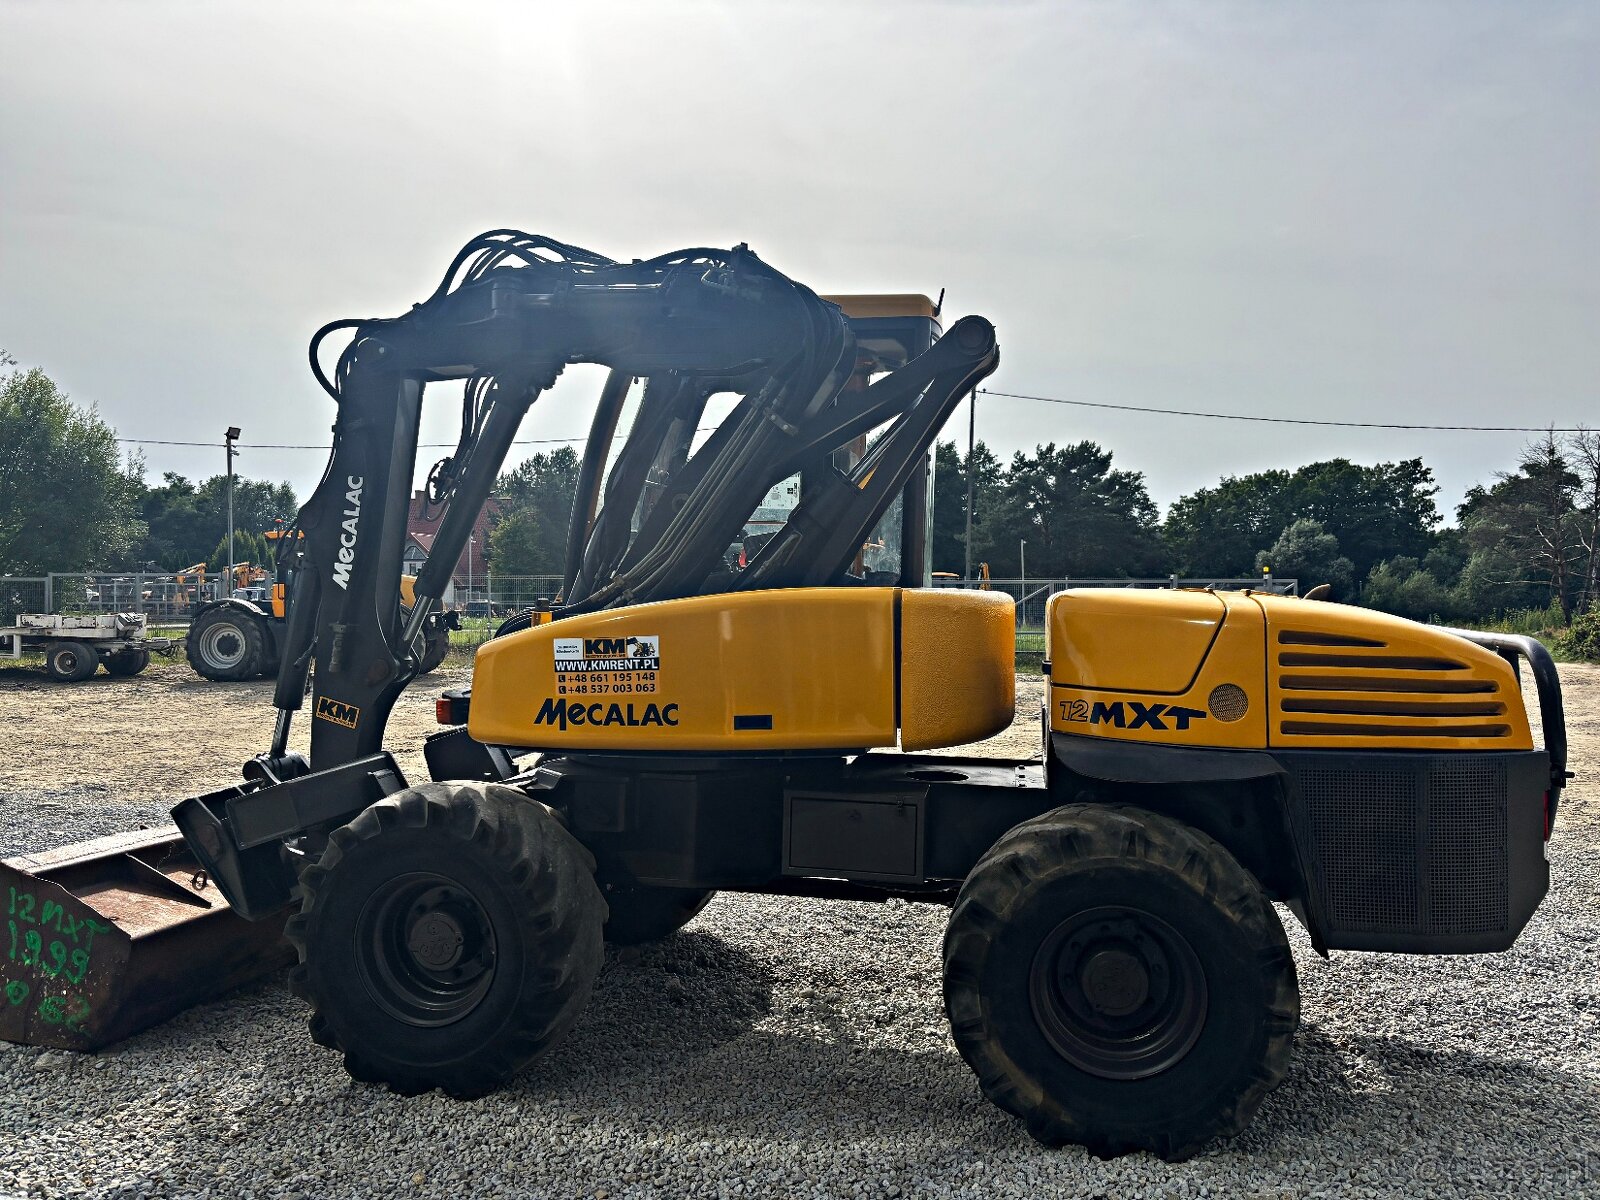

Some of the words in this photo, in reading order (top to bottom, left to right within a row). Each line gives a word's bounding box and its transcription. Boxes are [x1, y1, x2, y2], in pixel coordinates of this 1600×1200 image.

[585, 639, 625, 654] KM
[555, 658, 658, 672] WWW.KMRENT.PL
[567, 673, 587, 683] +48
[590, 673, 609, 683] 661
[613, 672, 632, 682] 195
[635, 672, 656, 682] 148
[567, 685, 587, 695] +48
[590, 684, 610, 694] 537
[613, 684, 632, 694] 003
[635, 683, 656, 693] 063
[319, 698, 358, 723] KM
[8, 920, 90, 984] 1999
